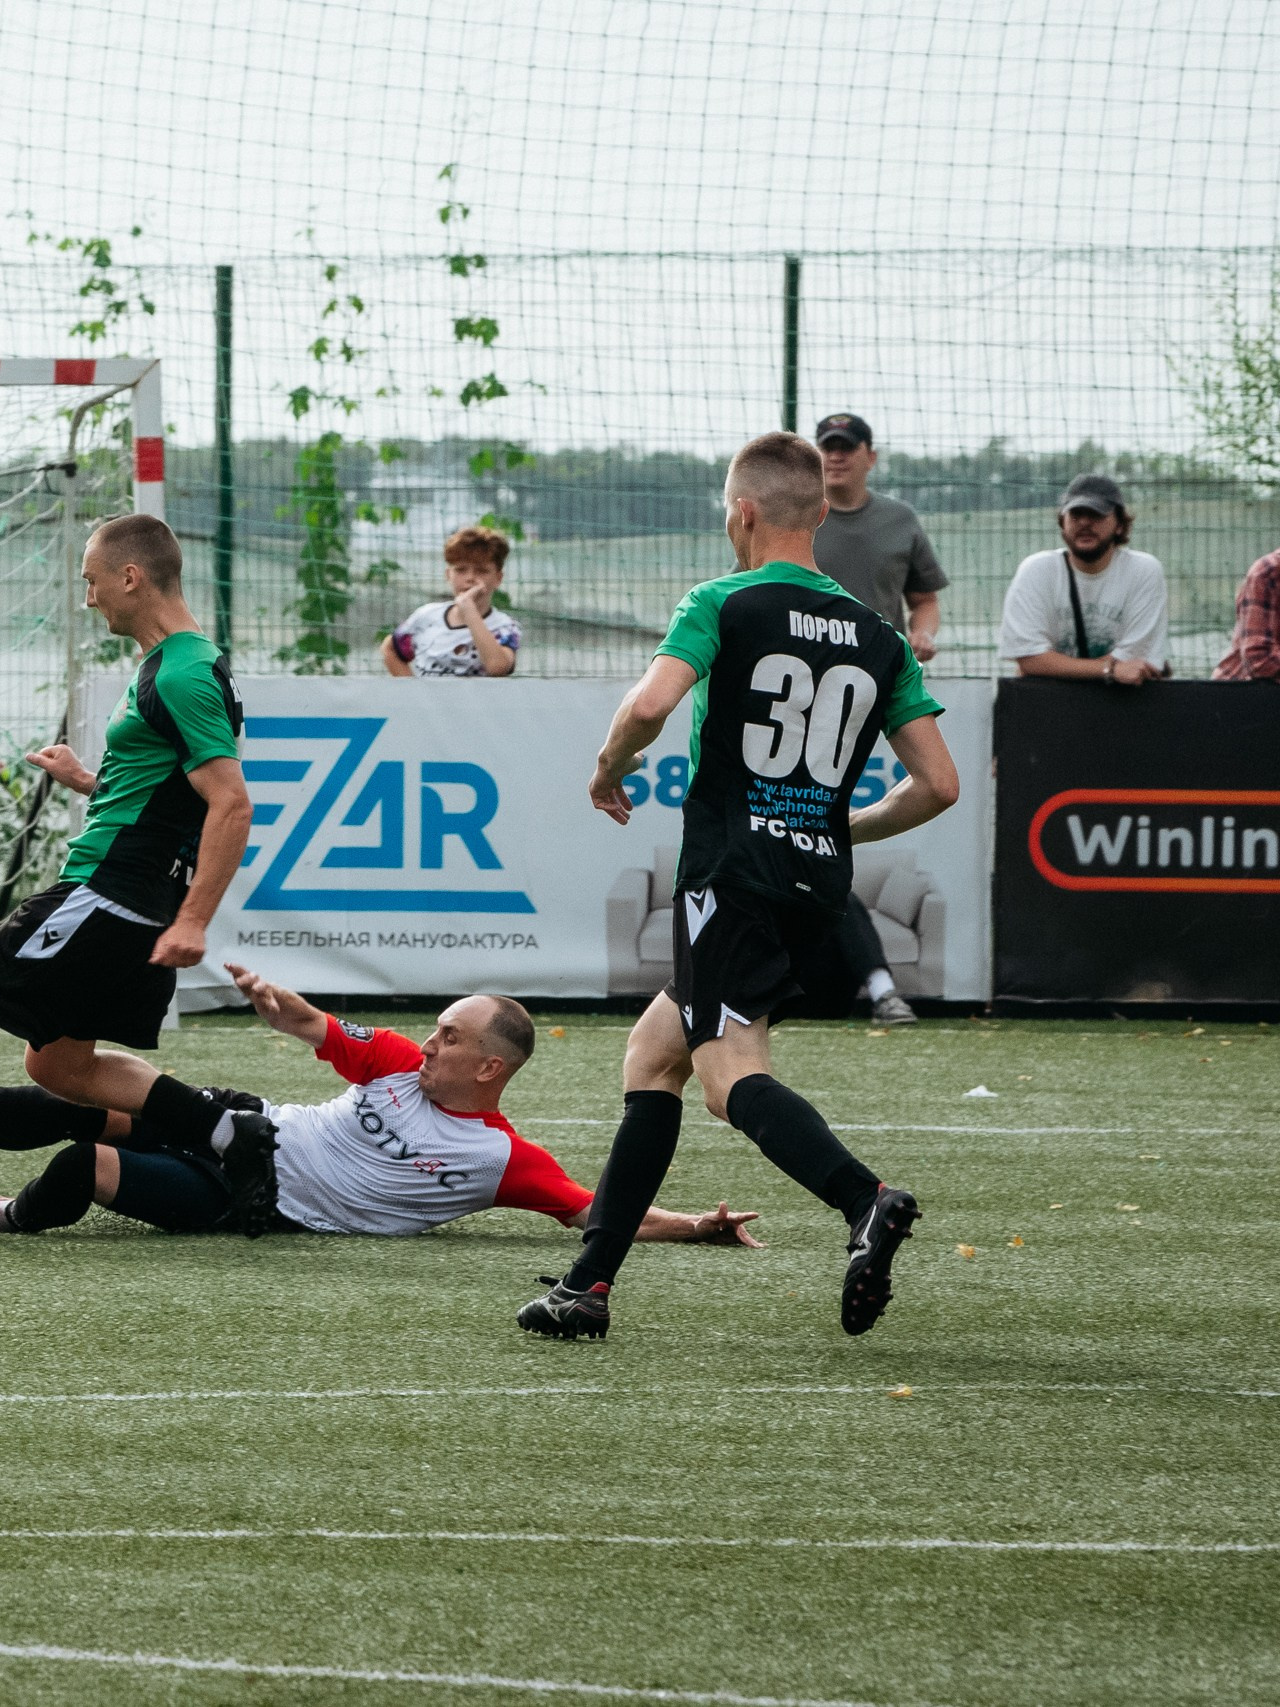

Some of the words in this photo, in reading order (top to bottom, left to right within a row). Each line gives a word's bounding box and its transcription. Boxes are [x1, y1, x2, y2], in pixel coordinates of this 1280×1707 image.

[788, 610, 859, 648] ПОРОХ
[741, 653, 878, 789] 30
[1067, 814, 1279, 868] Winlin
[237, 931, 371, 948] МЕБЕЛЬНАЯ
[377, 932, 539, 950] МАНУФАКТУРА
